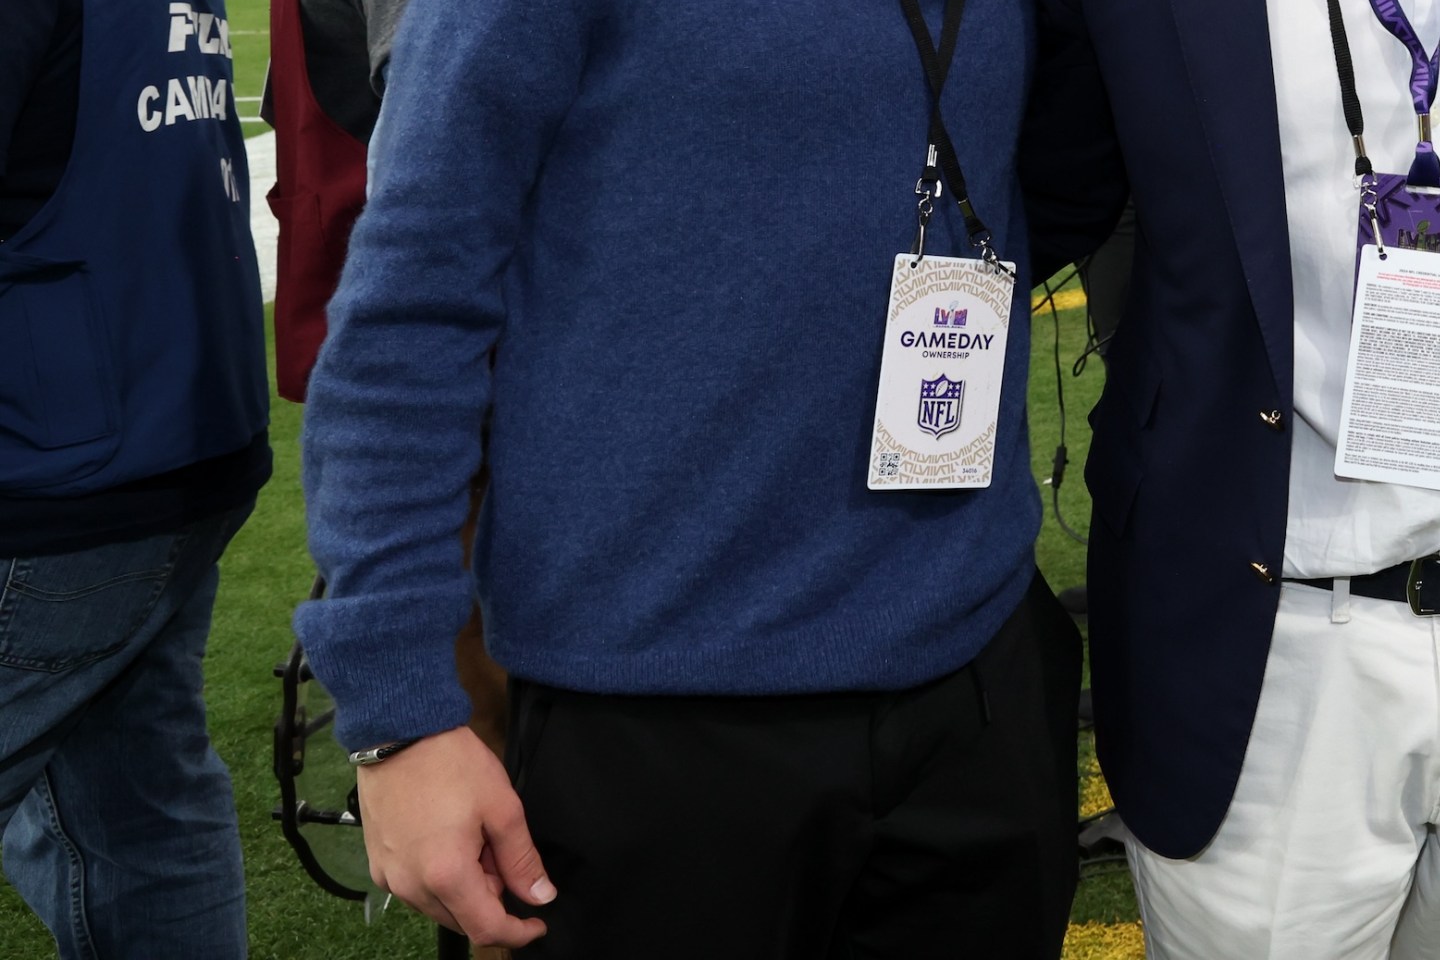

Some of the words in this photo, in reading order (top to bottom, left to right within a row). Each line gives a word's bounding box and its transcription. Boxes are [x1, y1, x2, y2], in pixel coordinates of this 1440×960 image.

[900, 330, 994, 350] GAMEDAY
[922, 350, 970, 360] OWNERSHIP
[921, 401, 955, 428] NFL
